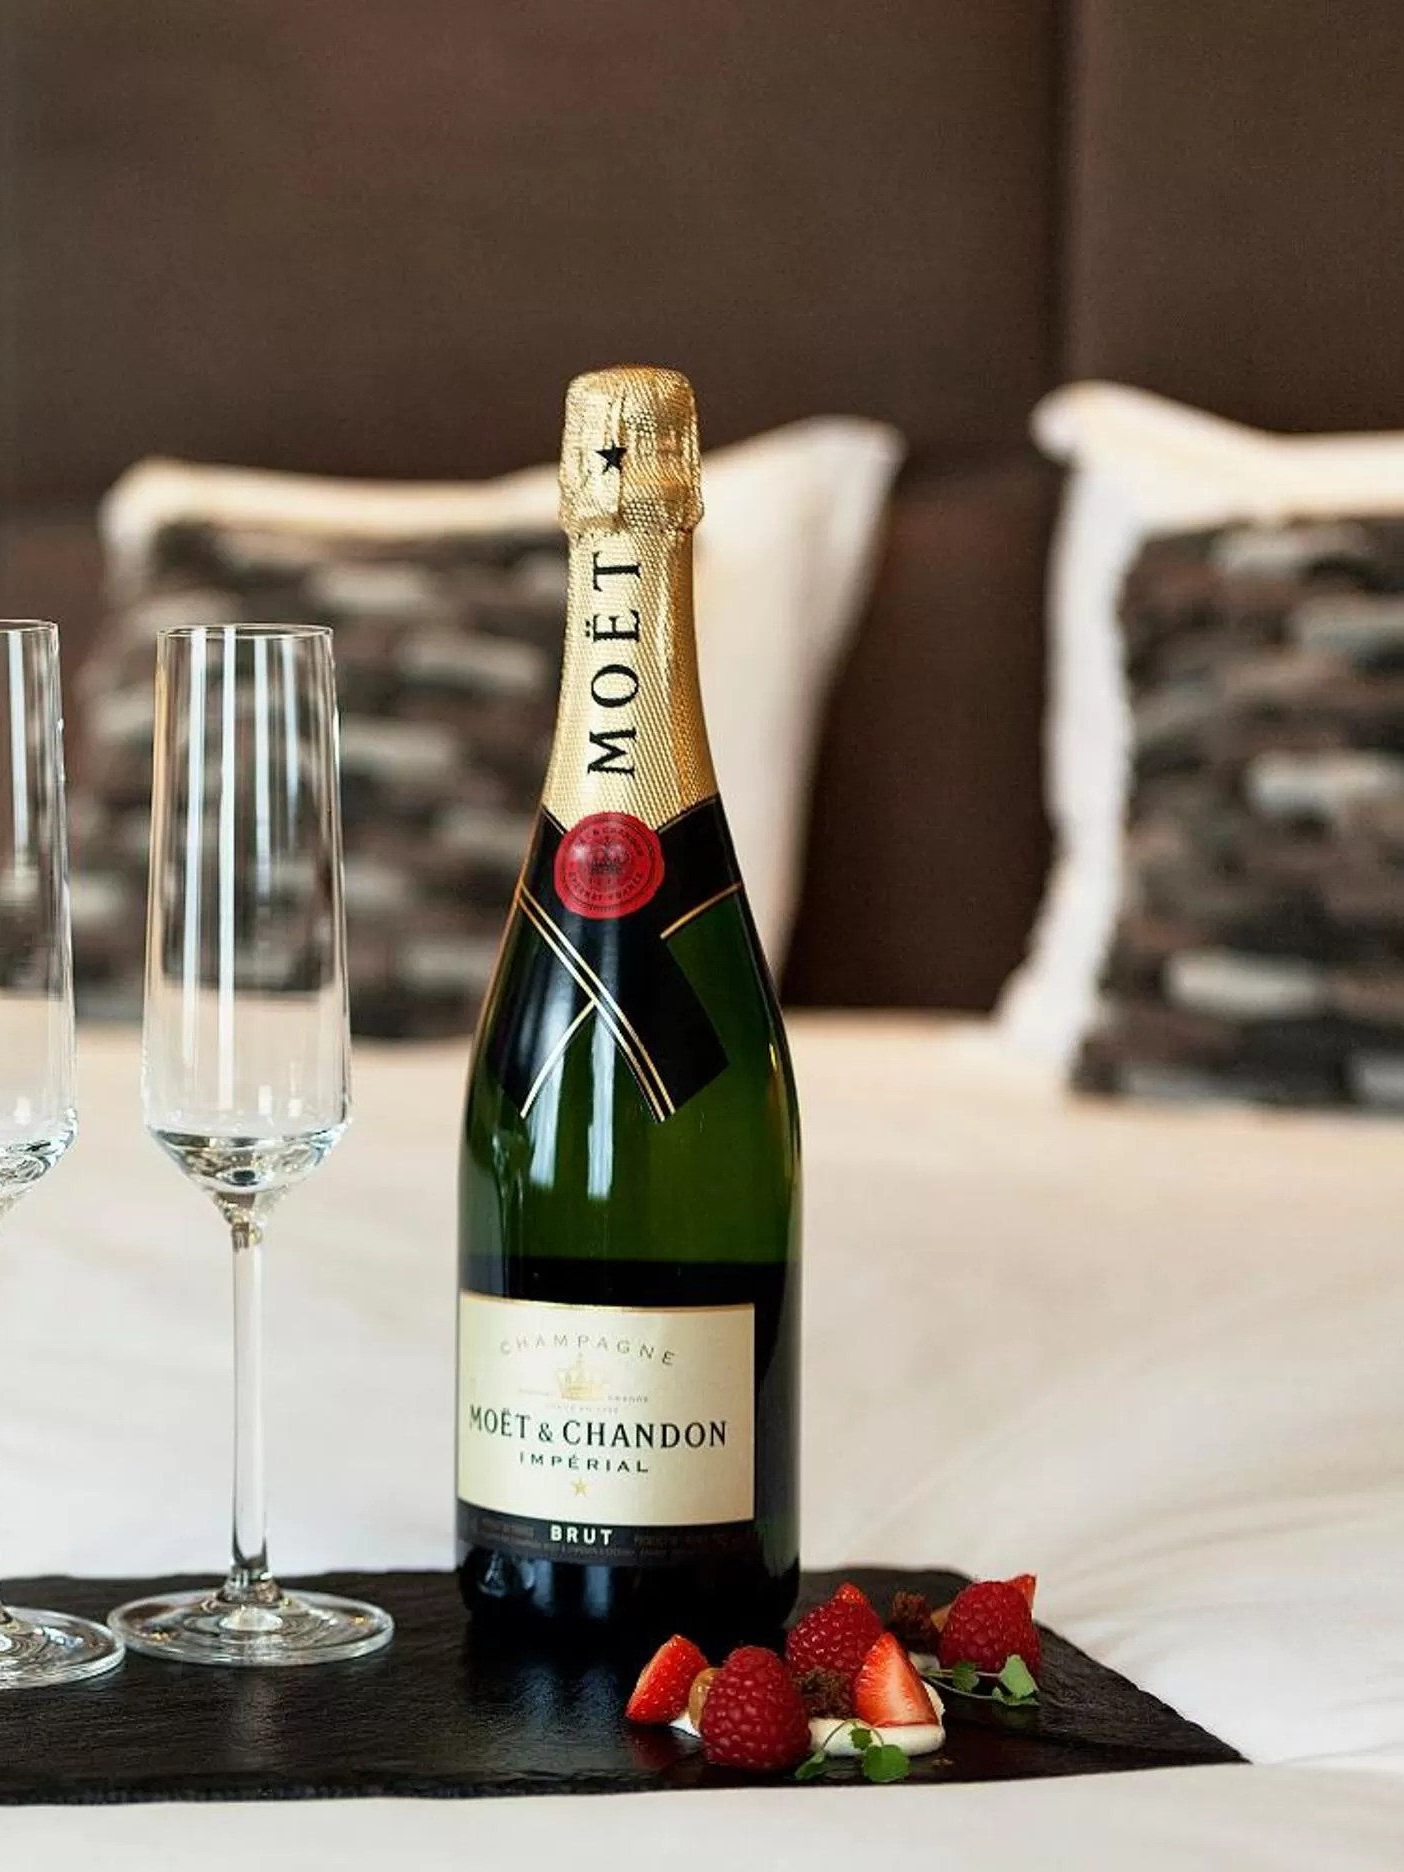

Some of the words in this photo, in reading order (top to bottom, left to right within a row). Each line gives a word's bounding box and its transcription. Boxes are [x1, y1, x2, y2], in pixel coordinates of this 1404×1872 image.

[586, 552, 641, 779] MOËT
[500, 1334, 675, 1365] CHAMPAGNE
[469, 1404, 530, 1439] MOËT
[538, 1426, 553, 1443] &
[562, 1420, 727, 1449] CHANDON
[520, 1452, 649, 1473] IMPÉRIAL
[550, 1525, 613, 1546] BRUT
